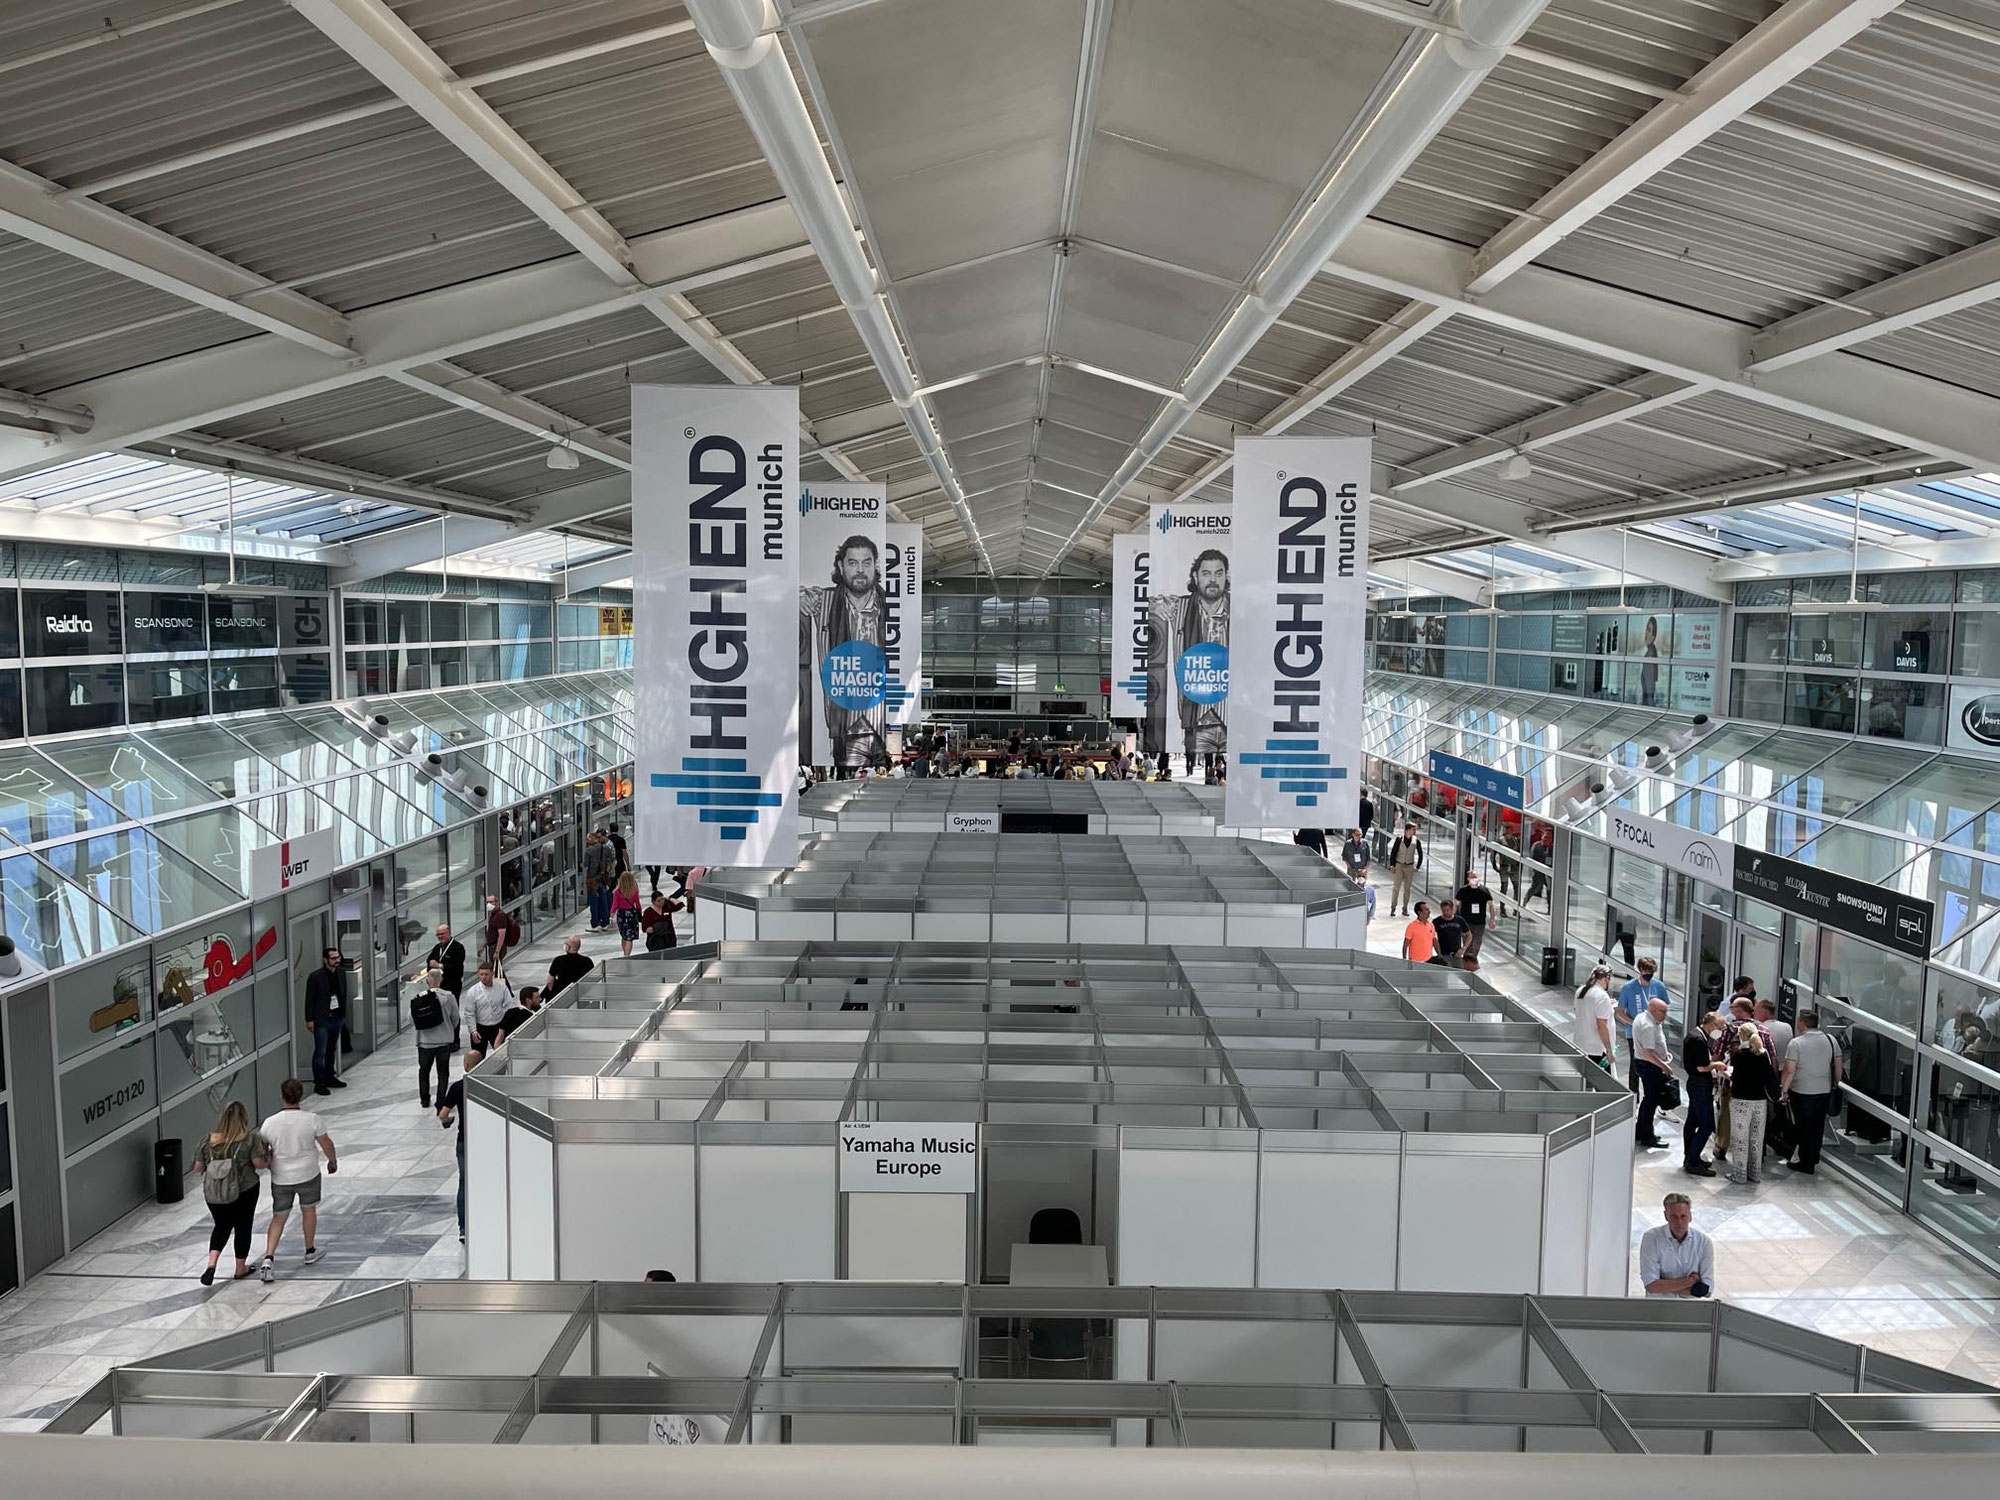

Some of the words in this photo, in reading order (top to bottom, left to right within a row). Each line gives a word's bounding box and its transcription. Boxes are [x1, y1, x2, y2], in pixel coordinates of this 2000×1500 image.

[757, 443, 783, 560] munich
[1335, 483, 1357, 577] munich
[904, 546, 916, 595] munich
[46, 614, 93, 632] Raidho
[134, 618, 193, 628] SCANSONIC
[215, 618, 266, 628] SCANSONIC
[830, 656, 860, 671] THE
[1184, 656, 1211, 669] THE
[1814, 653, 1832, 663] DAVIS
[1896, 656, 1917, 668] DAVIS
[830, 672, 884, 686] MAGIC
[1184, 670, 1230, 682] MAGIC
[831, 688, 846, 696] OF
[848, 688, 880, 697] MUSIC
[1184, 684, 1196, 692] OF
[1198, 684, 1228, 693] MUSIC
[954, 816, 992, 827] Gryphon
[1623, 824, 1655, 848] FOCAL
[1690, 850, 1712, 870] naim
[282, 859, 310, 878] WBT
[1837, 892, 1883, 914] SNOWSOUND
[1900, 918, 1923, 936] spl
[82, 1078, 145, 1124] WBT-0120
[842, 1137, 915, 1152] Yamaha
[922, 1138, 975, 1153] Music
[876, 1160, 942, 1178] Europe
